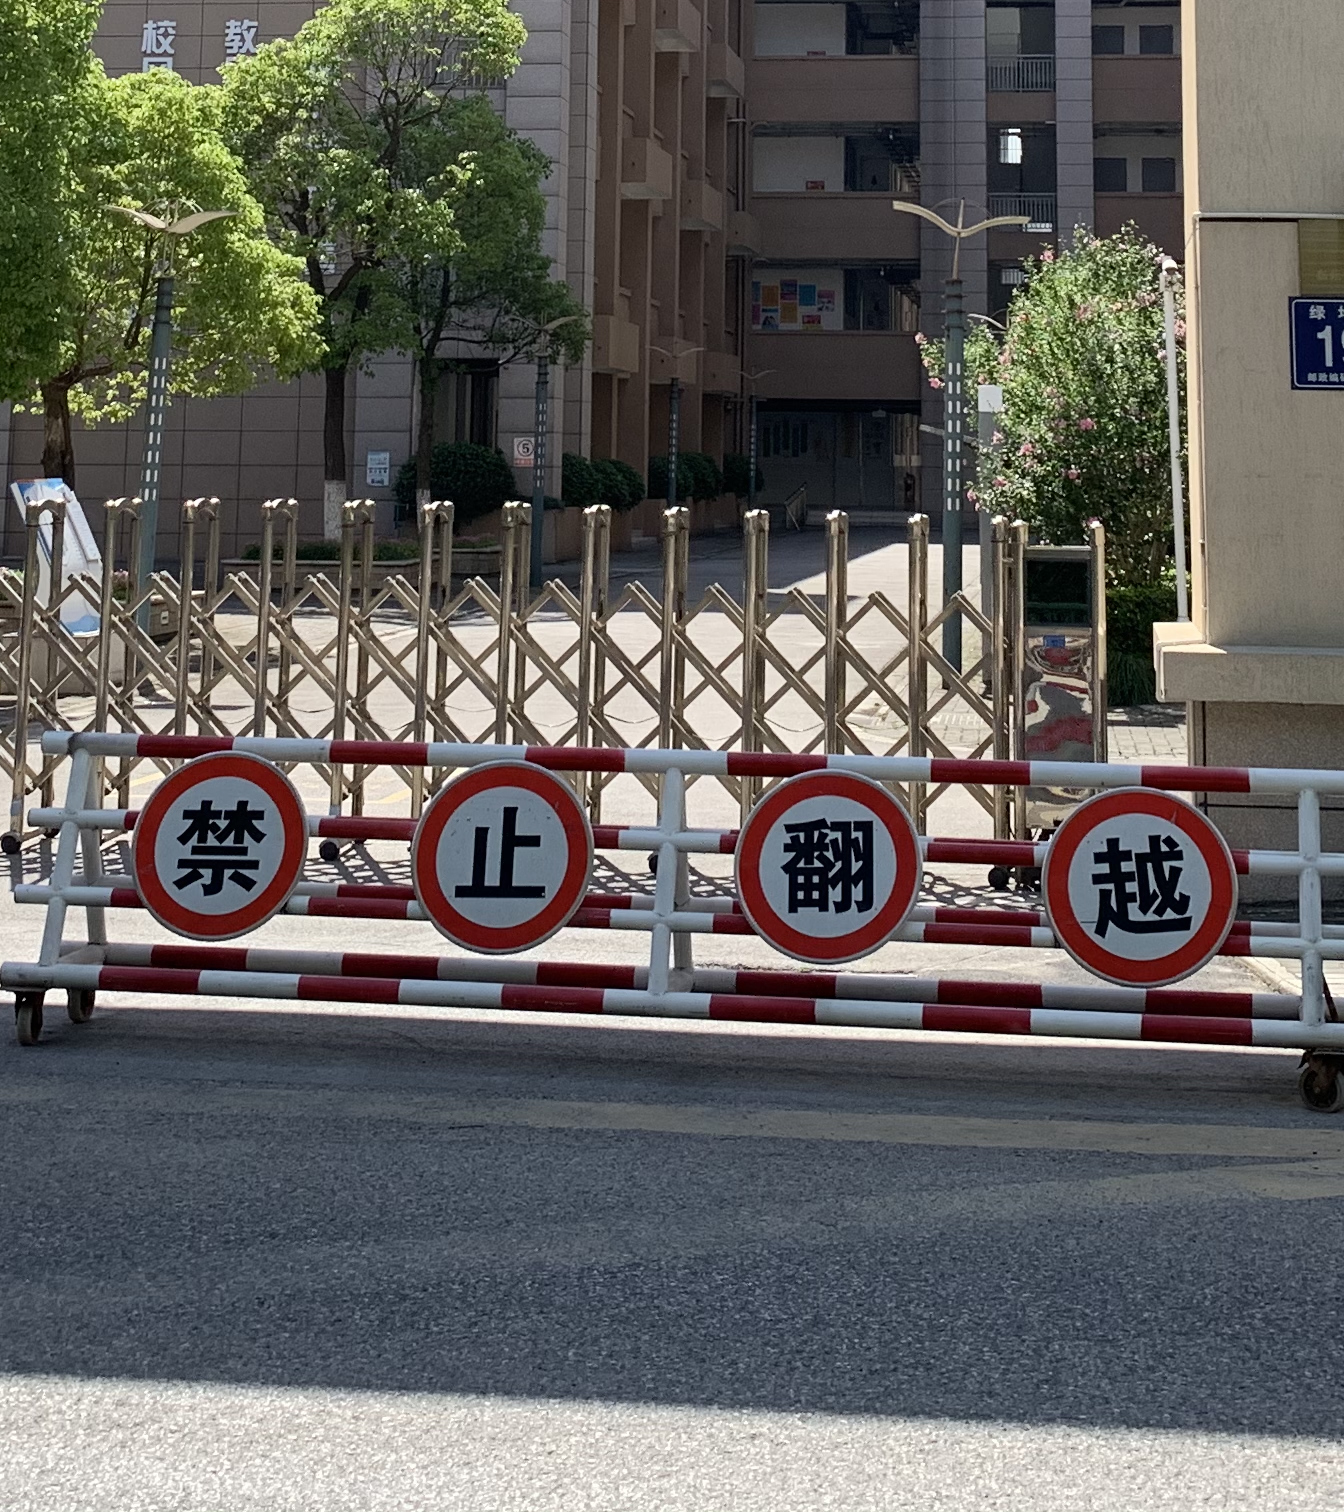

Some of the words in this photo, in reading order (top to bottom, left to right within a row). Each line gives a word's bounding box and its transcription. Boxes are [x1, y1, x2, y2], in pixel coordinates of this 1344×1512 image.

[175, 799, 267, 895] 禁
[455, 806, 546, 900] 止
[780, 818, 875, 916] 翻
[1090, 834, 1193, 939] 越
